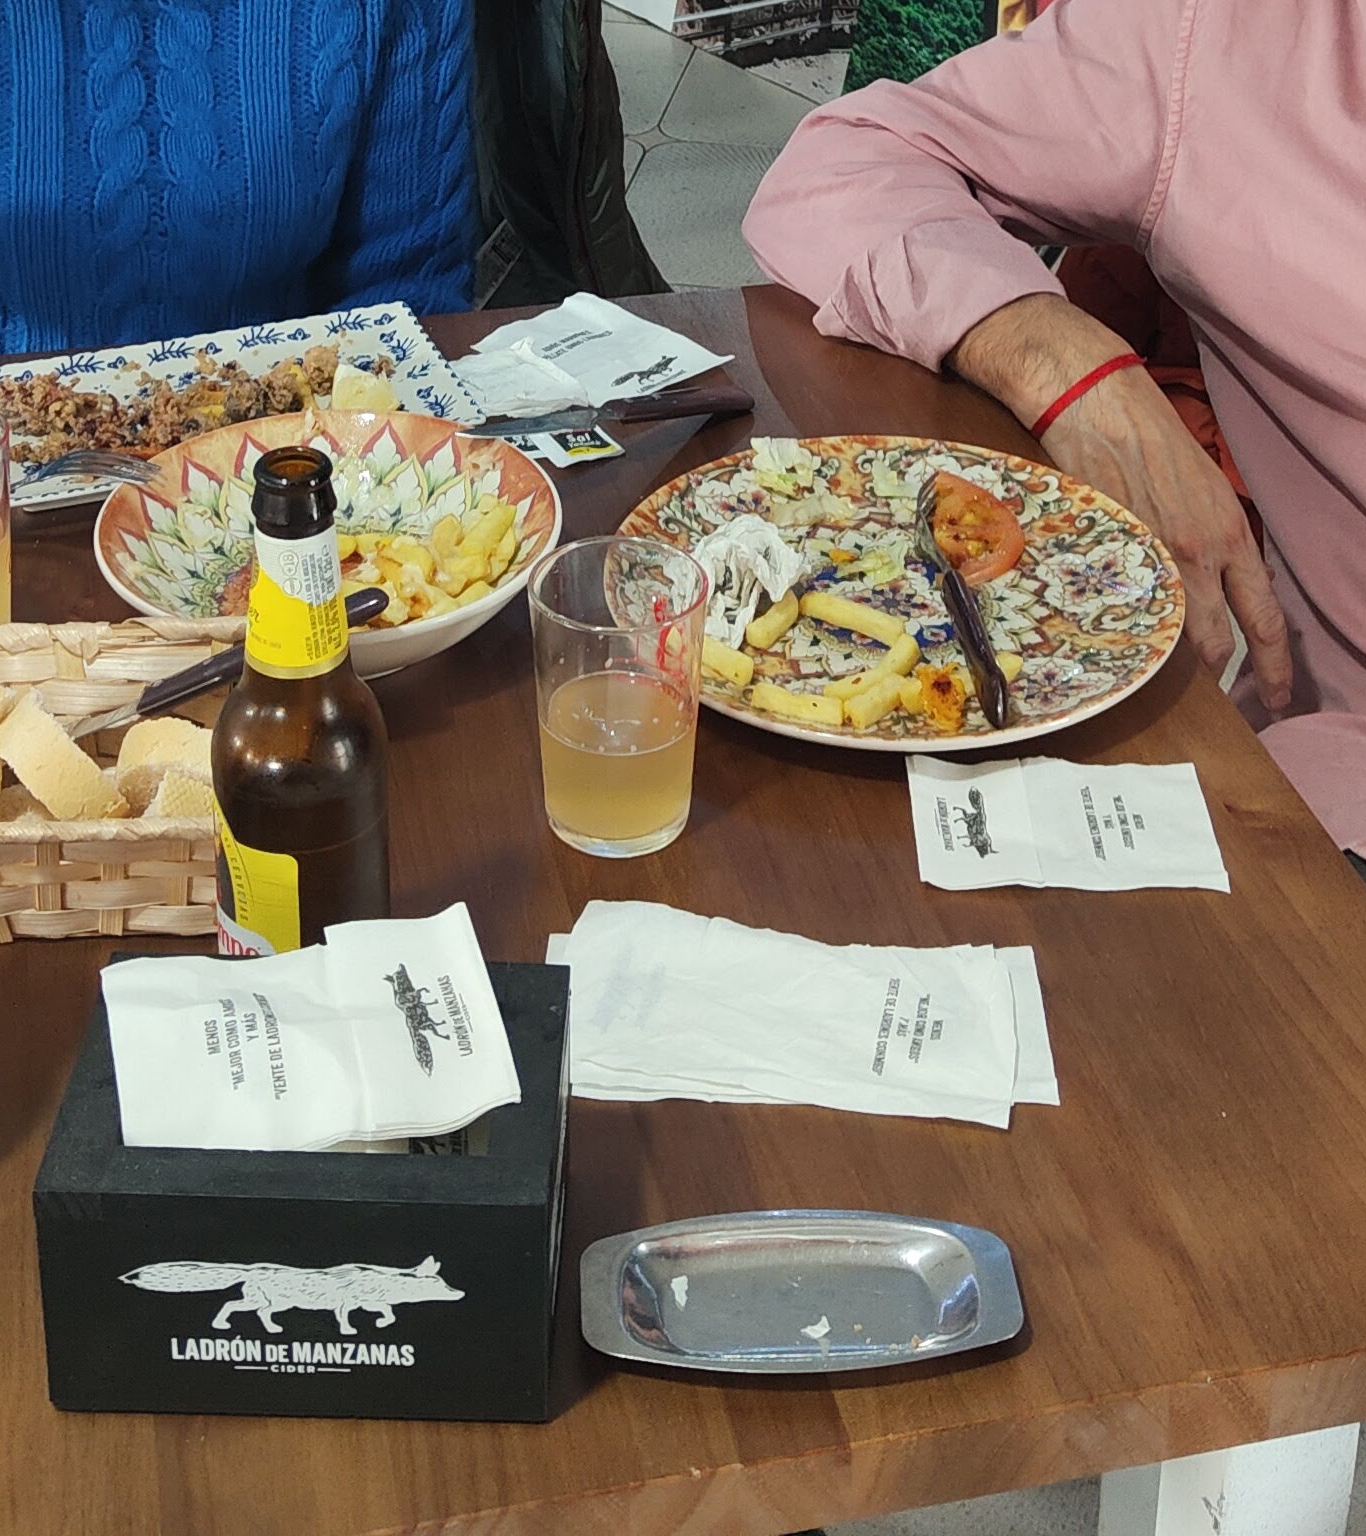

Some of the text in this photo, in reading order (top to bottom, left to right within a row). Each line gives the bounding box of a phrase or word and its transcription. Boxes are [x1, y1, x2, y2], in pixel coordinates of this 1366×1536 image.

[241, 1013, 259, 1042] Y MÁS
[437, 975, 473, 1057] LADRÓN DE MANZANAS
[204, 1019, 221, 1055] MENOS
[224, 1019, 241, 1048] COMO
[268, 1047, 283, 1061] DE
[171, 1335, 415, 1366] LADRÓN DE MANZANAS
[270, 1365, 316, 1374] CIDER
